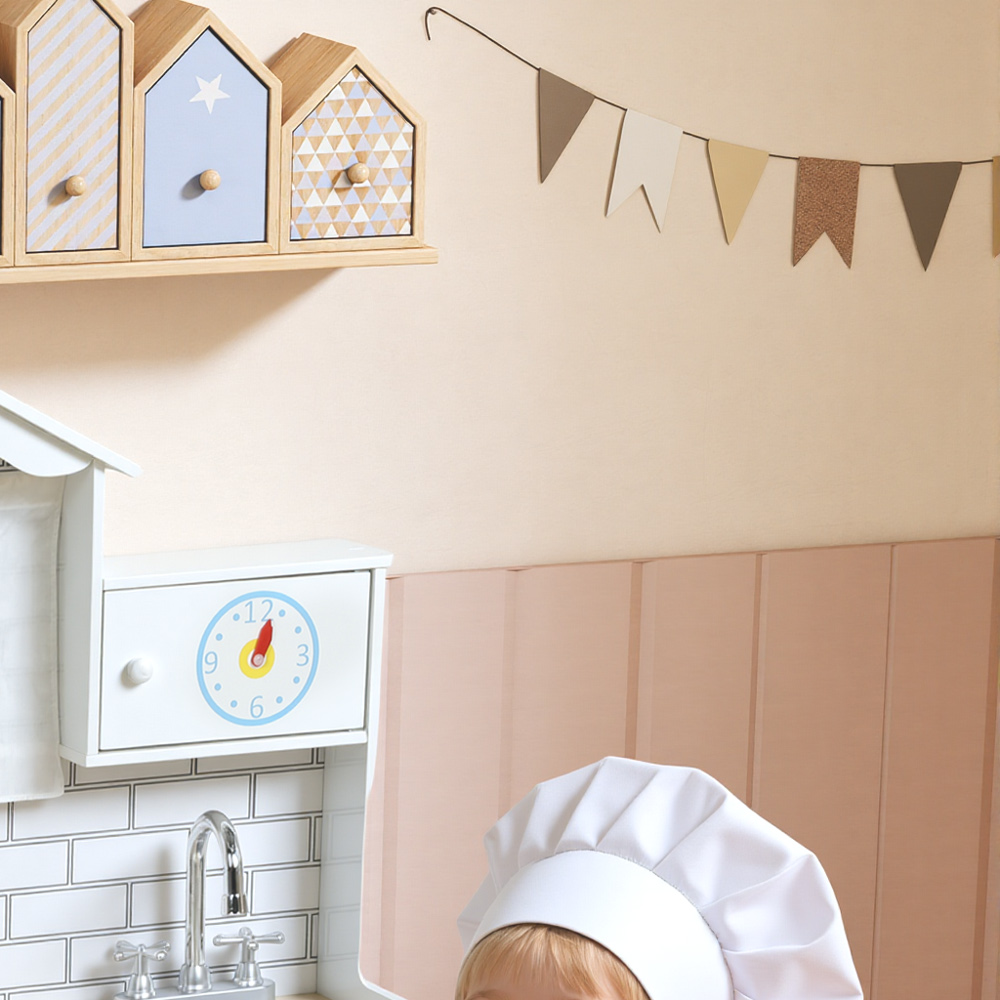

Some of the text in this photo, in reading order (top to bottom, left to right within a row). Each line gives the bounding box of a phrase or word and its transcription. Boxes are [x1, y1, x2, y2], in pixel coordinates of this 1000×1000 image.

[244, 599, 274, 623] 12
[204, 651, 218, 674] 9
[296, 644, 309, 666] 3
[250, 695, 264, 718] 6
